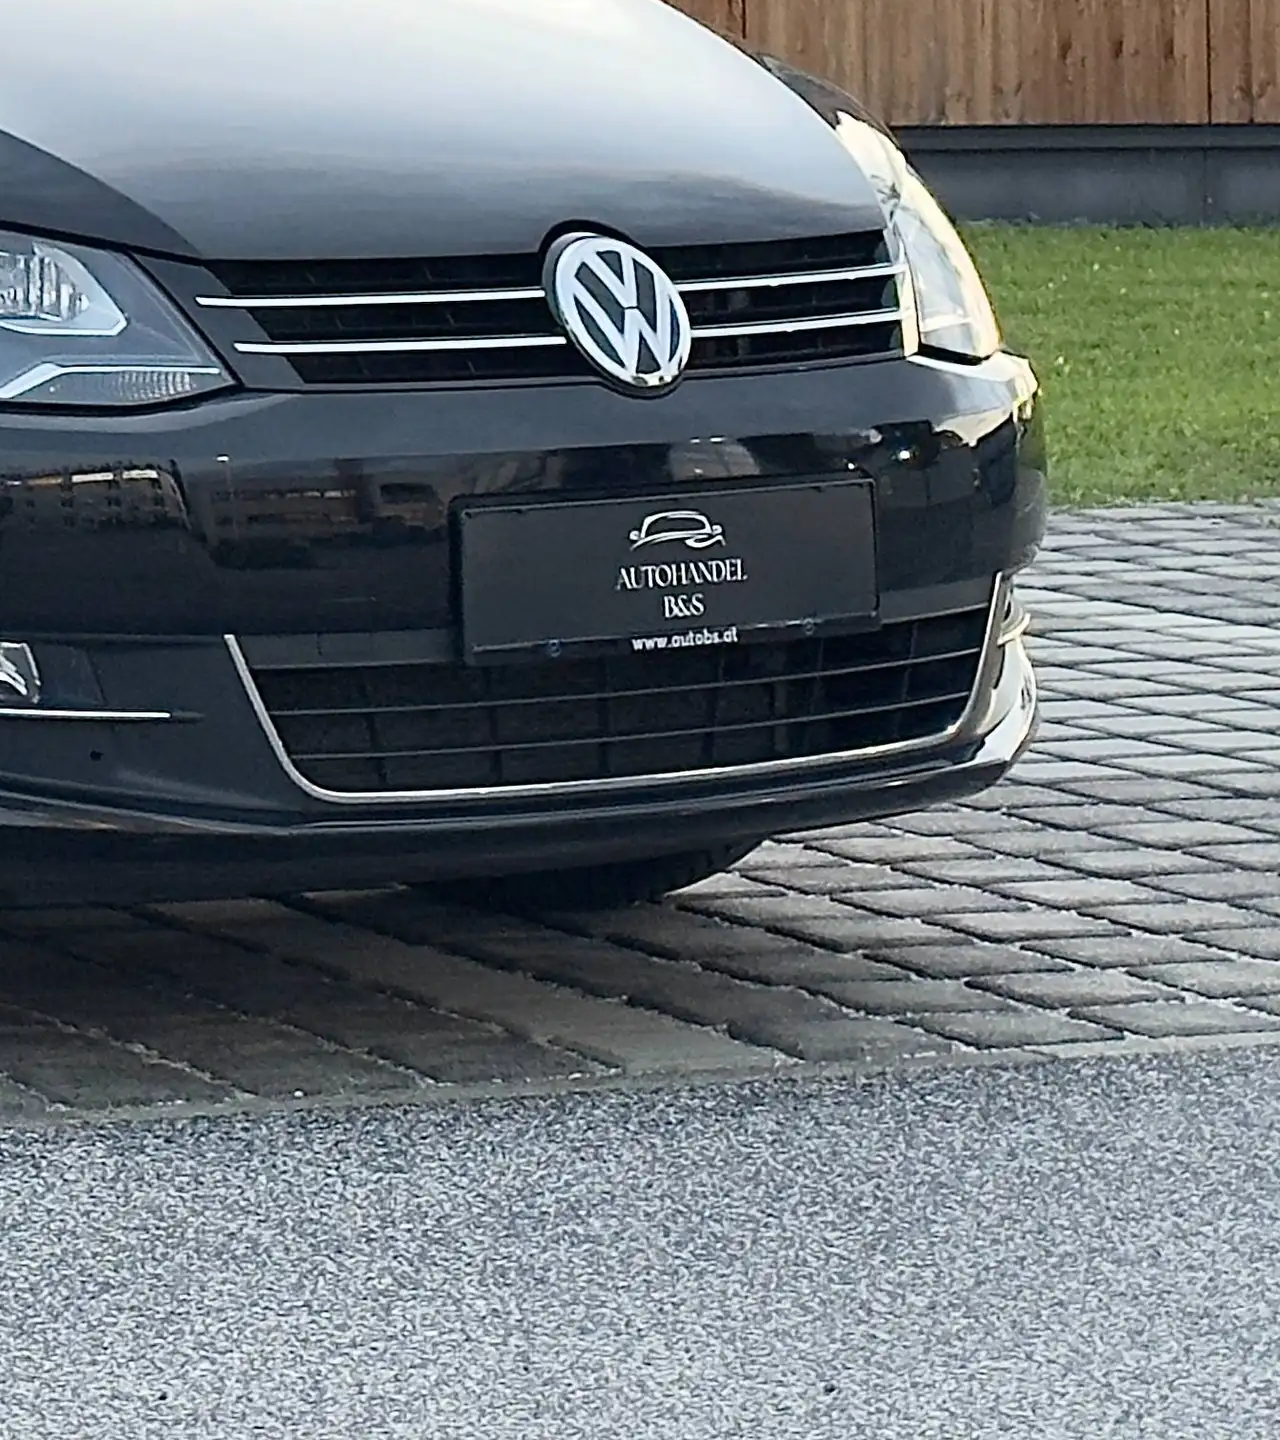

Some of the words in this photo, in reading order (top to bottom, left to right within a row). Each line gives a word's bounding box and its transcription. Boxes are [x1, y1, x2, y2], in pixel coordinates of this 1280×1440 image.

[615, 558, 748, 591] AUTOHANDEL
[663, 593, 705, 618] B&S
[632, 626, 739, 652] www.autobs.at
